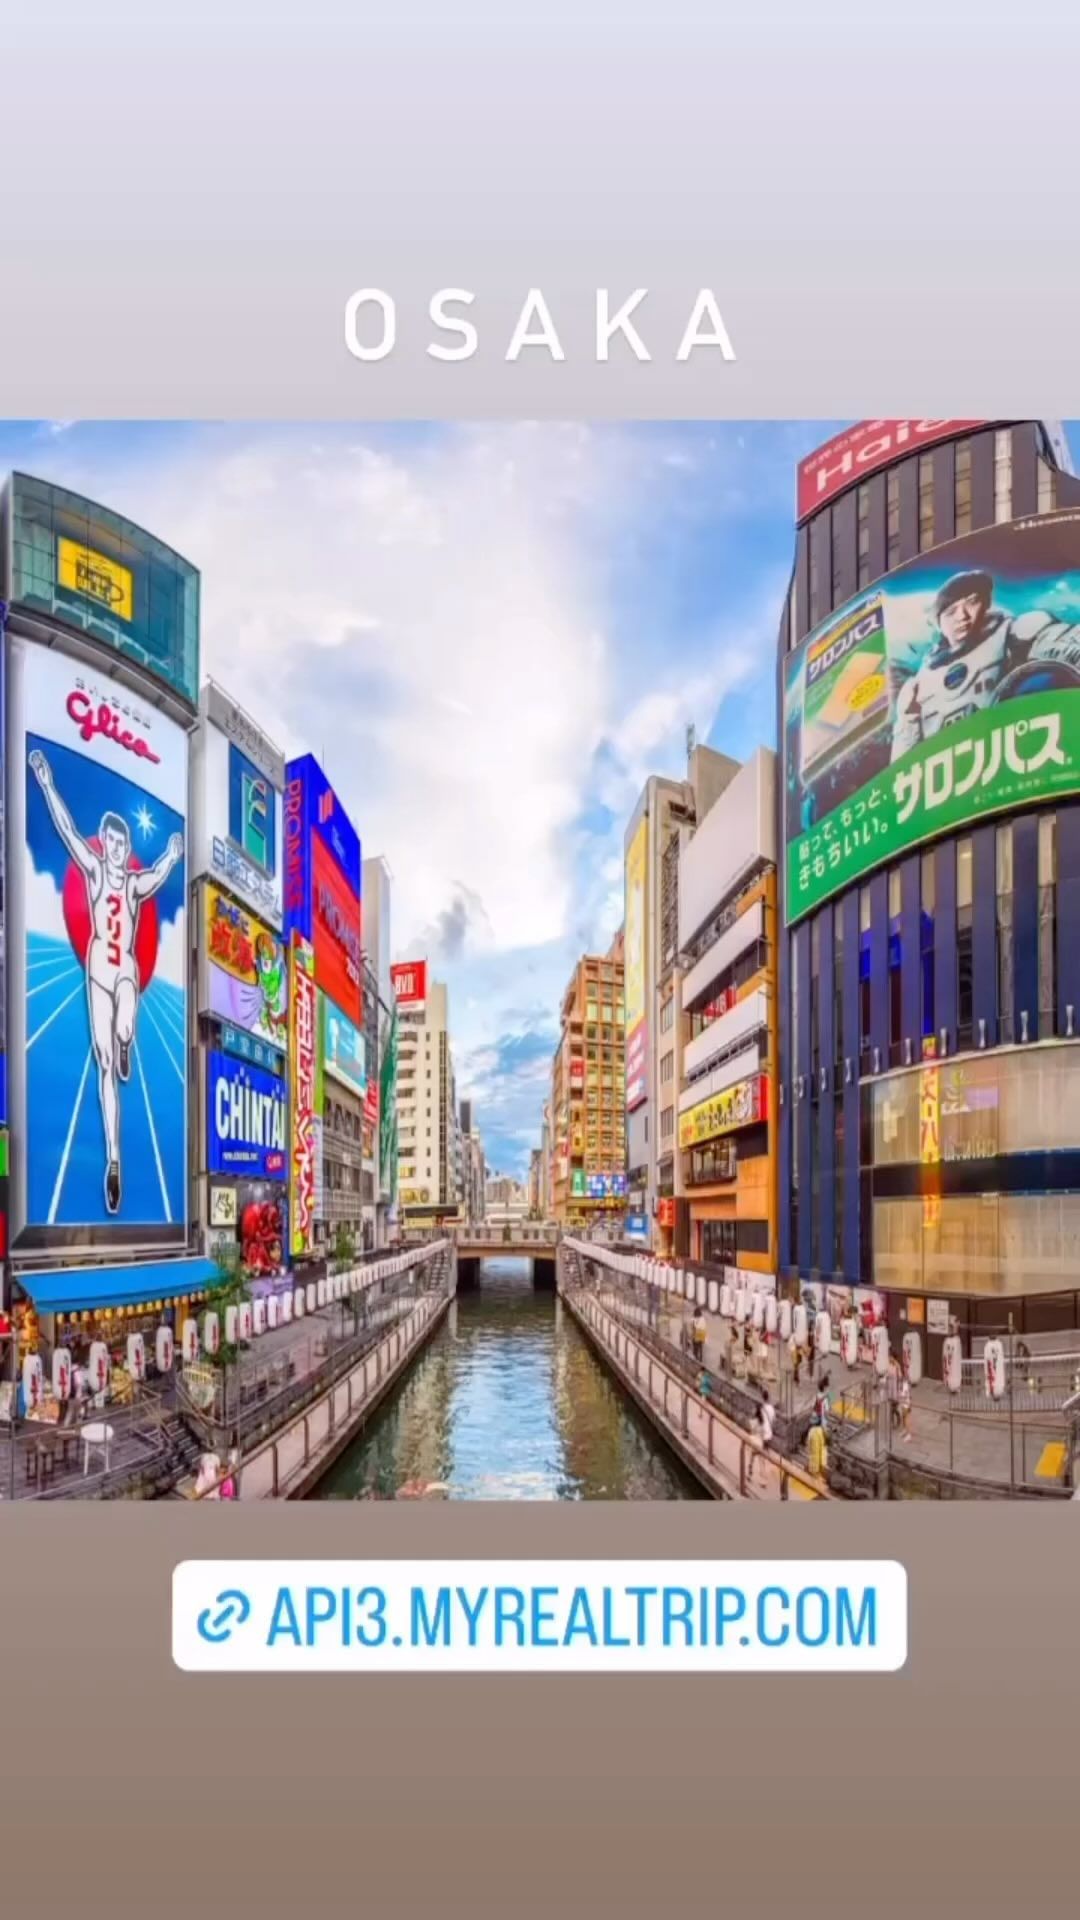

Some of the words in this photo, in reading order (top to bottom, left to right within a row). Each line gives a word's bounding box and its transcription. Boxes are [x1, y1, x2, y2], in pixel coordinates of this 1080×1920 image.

[66, 691, 160, 765] Glico
[106, 894, 121, 967] グリコ
